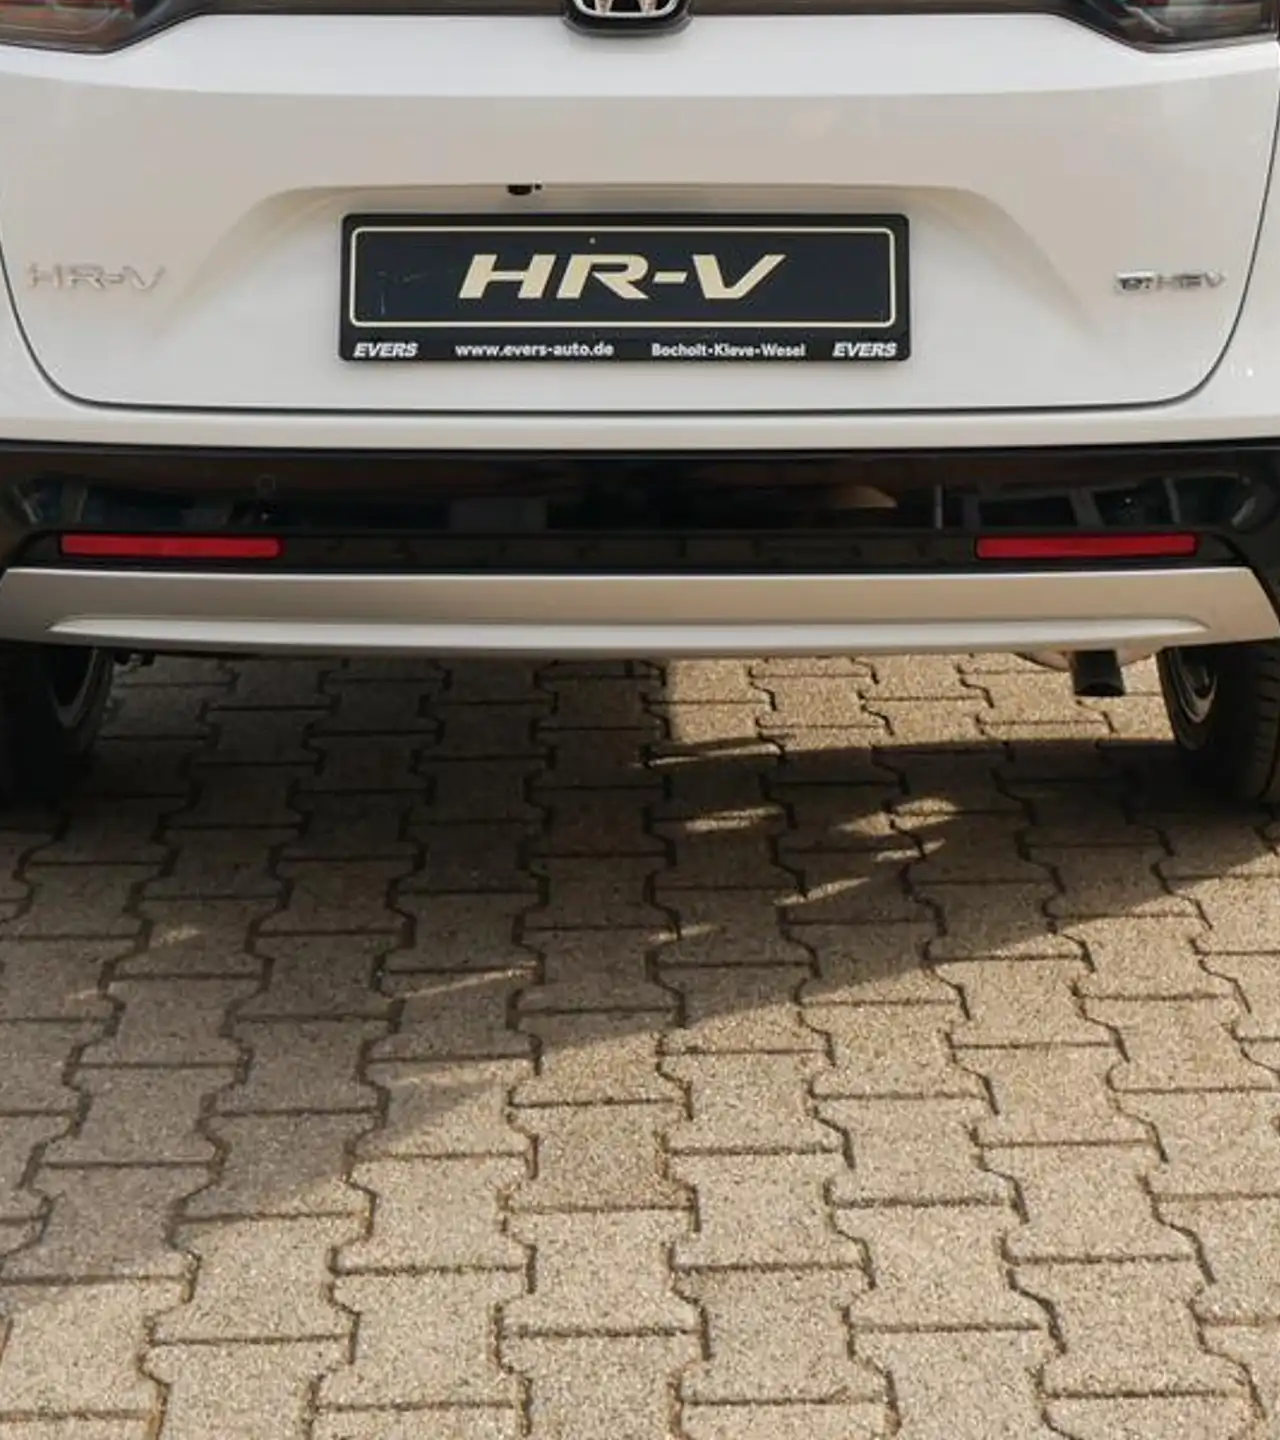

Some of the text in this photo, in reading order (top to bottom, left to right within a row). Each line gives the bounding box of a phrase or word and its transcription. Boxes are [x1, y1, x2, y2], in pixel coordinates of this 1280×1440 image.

[24, 261, 167, 292] HR-V
[458, 253, 787, 300] HR-V
[352, 342, 419, 358] EVERS
[455, 340, 615, 357] www.evers-auto.de
[832, 341, 898, 358] EVERS
